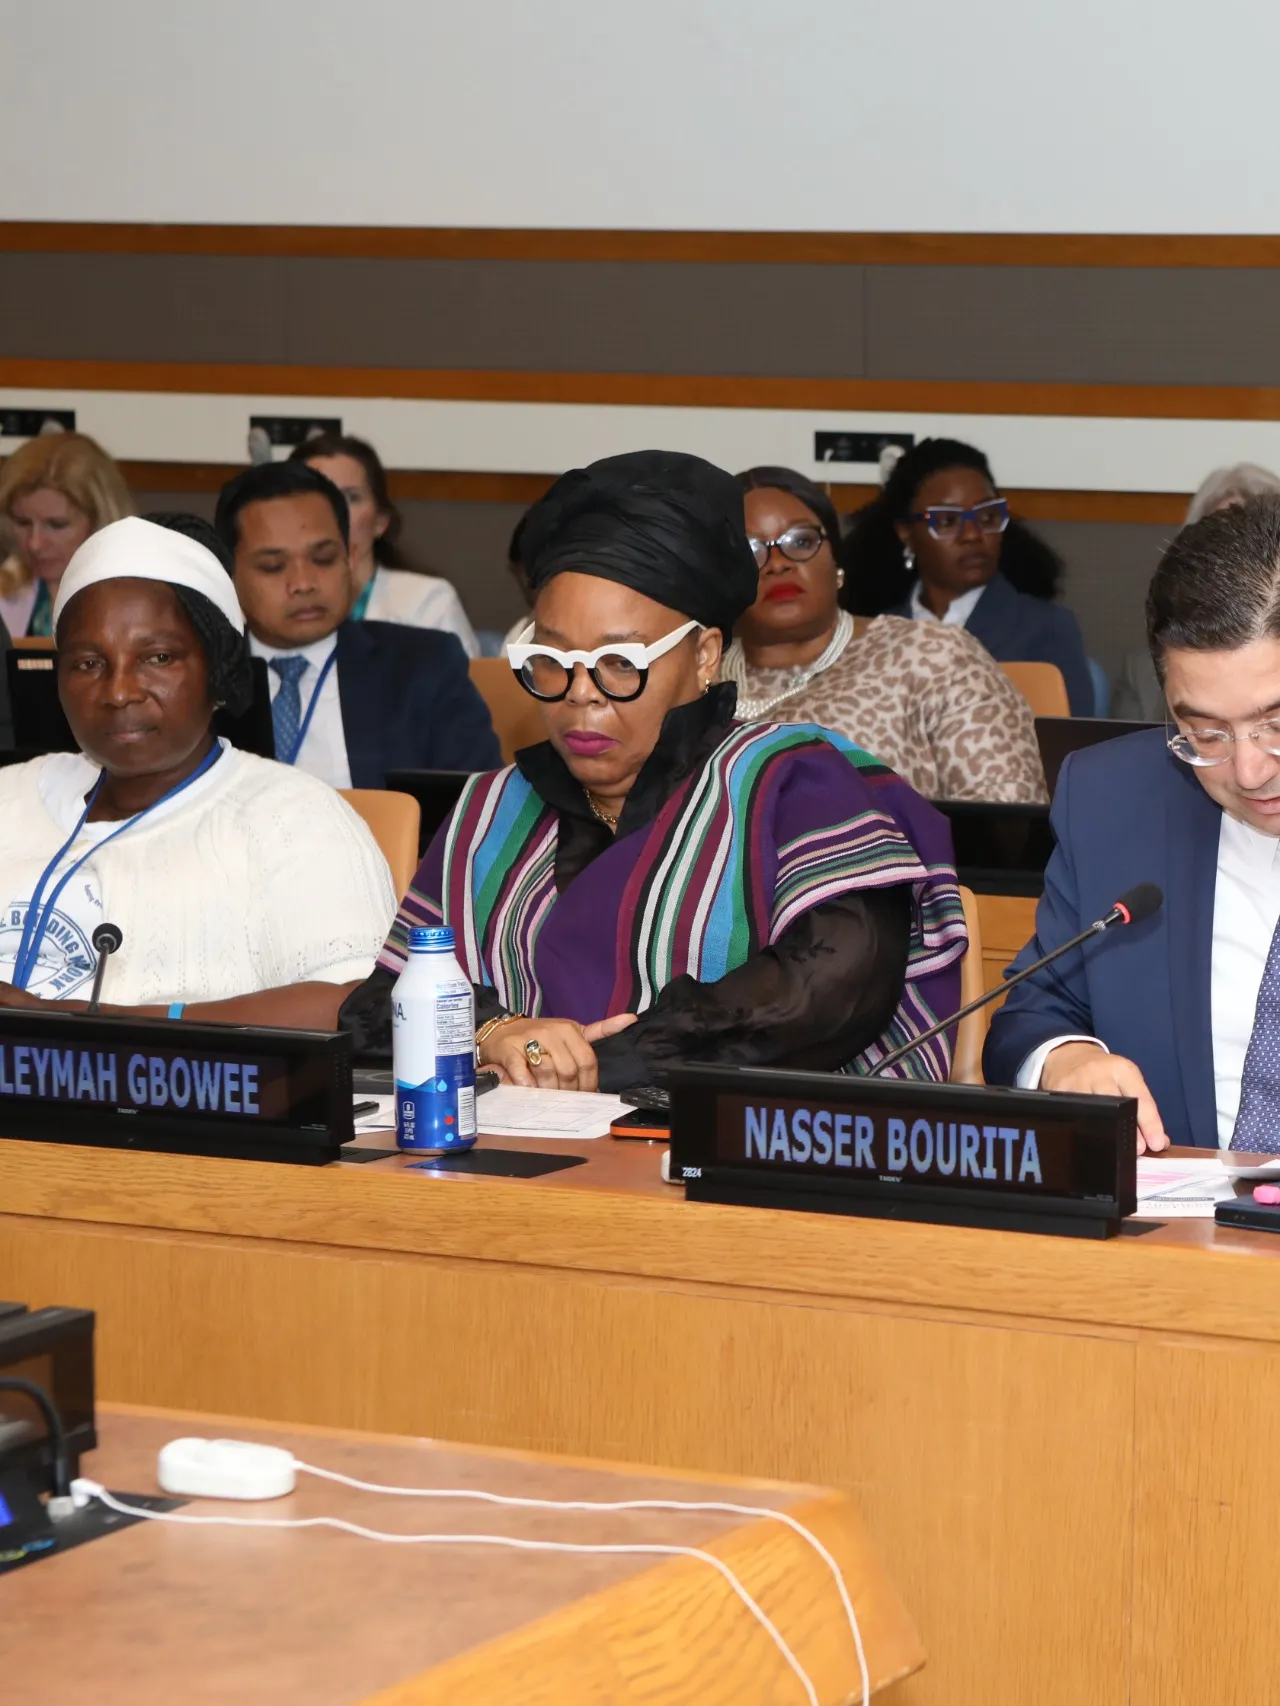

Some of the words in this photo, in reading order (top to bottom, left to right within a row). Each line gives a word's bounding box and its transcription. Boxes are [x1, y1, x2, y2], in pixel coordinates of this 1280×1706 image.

[0, 1044, 117, 1102] LEYMAH
[127, 1054, 259, 1114] GBOWEE
[745, 1106, 876, 1169] NASSER
[887, 1118, 1042, 1184] BOURITA
